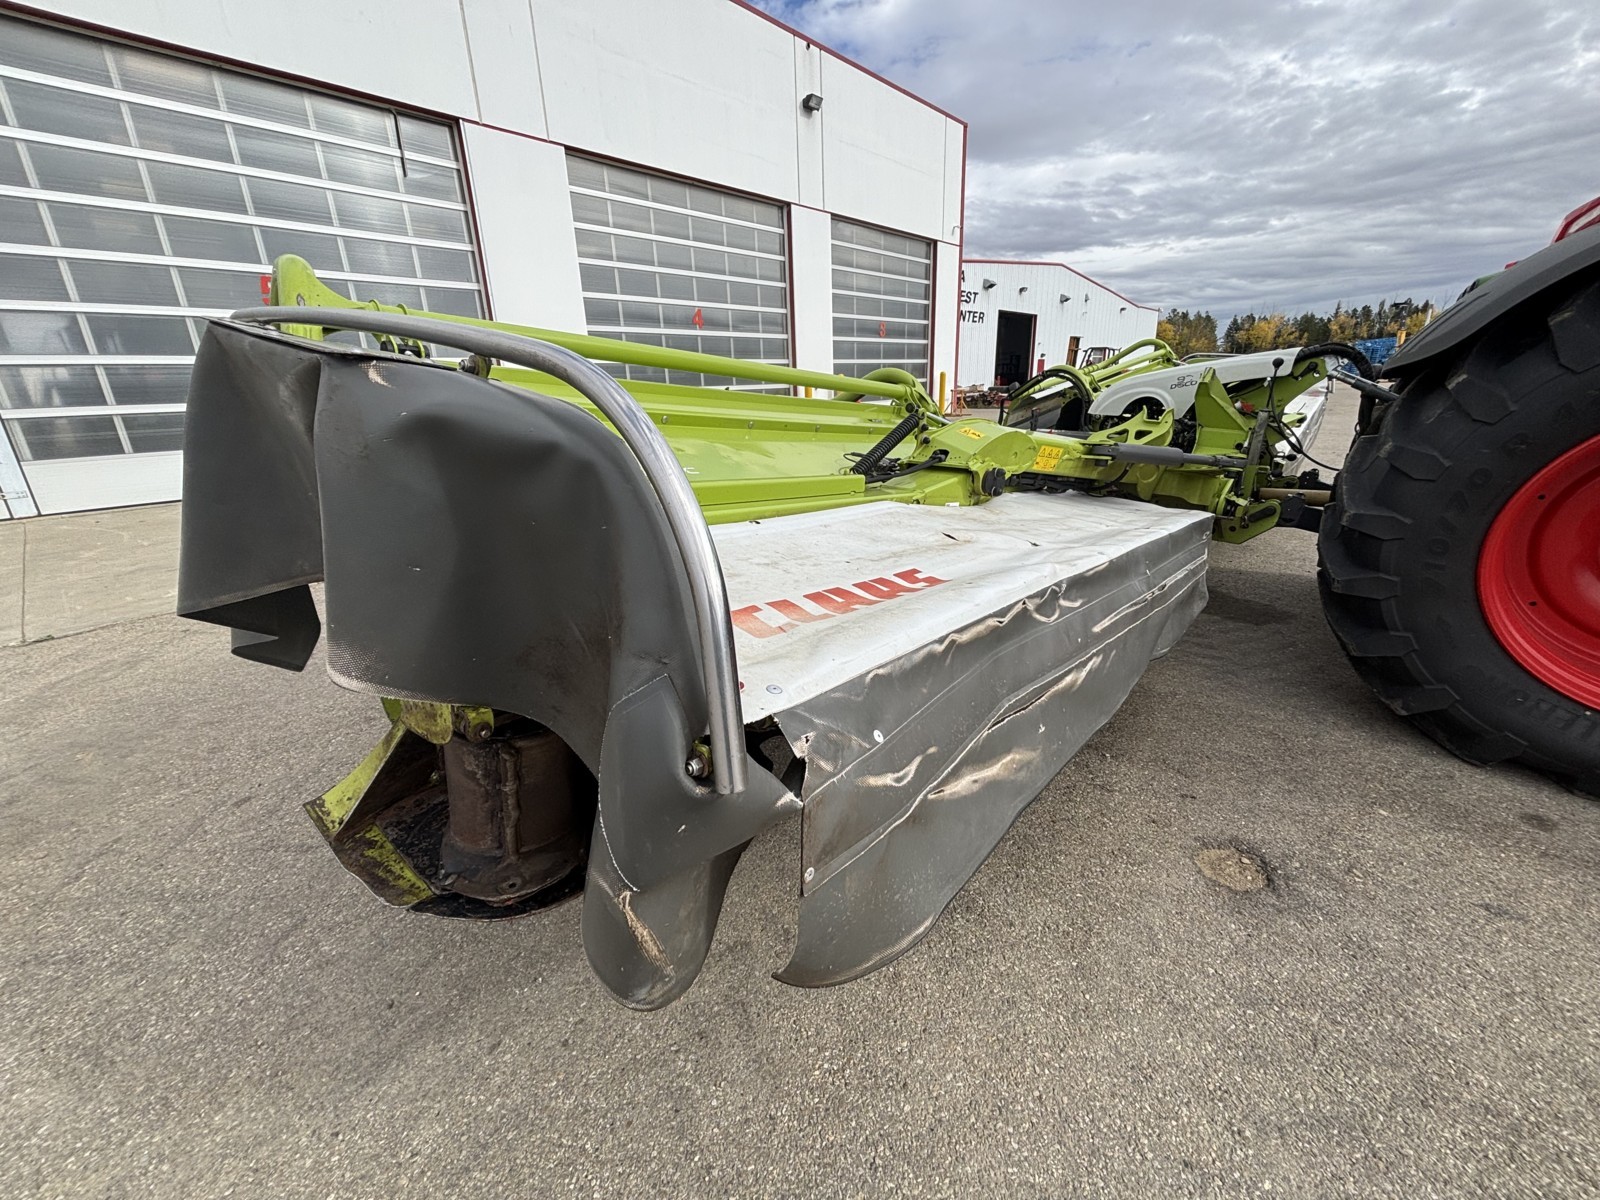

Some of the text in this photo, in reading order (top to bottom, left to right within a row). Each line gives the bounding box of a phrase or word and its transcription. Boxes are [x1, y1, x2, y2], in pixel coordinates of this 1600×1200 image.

[961, 290, 979, 304] EST
[692, 307, 704, 329] 4
[960, 310, 985, 324] NTER
[730, 568, 952, 639] CLAAS
